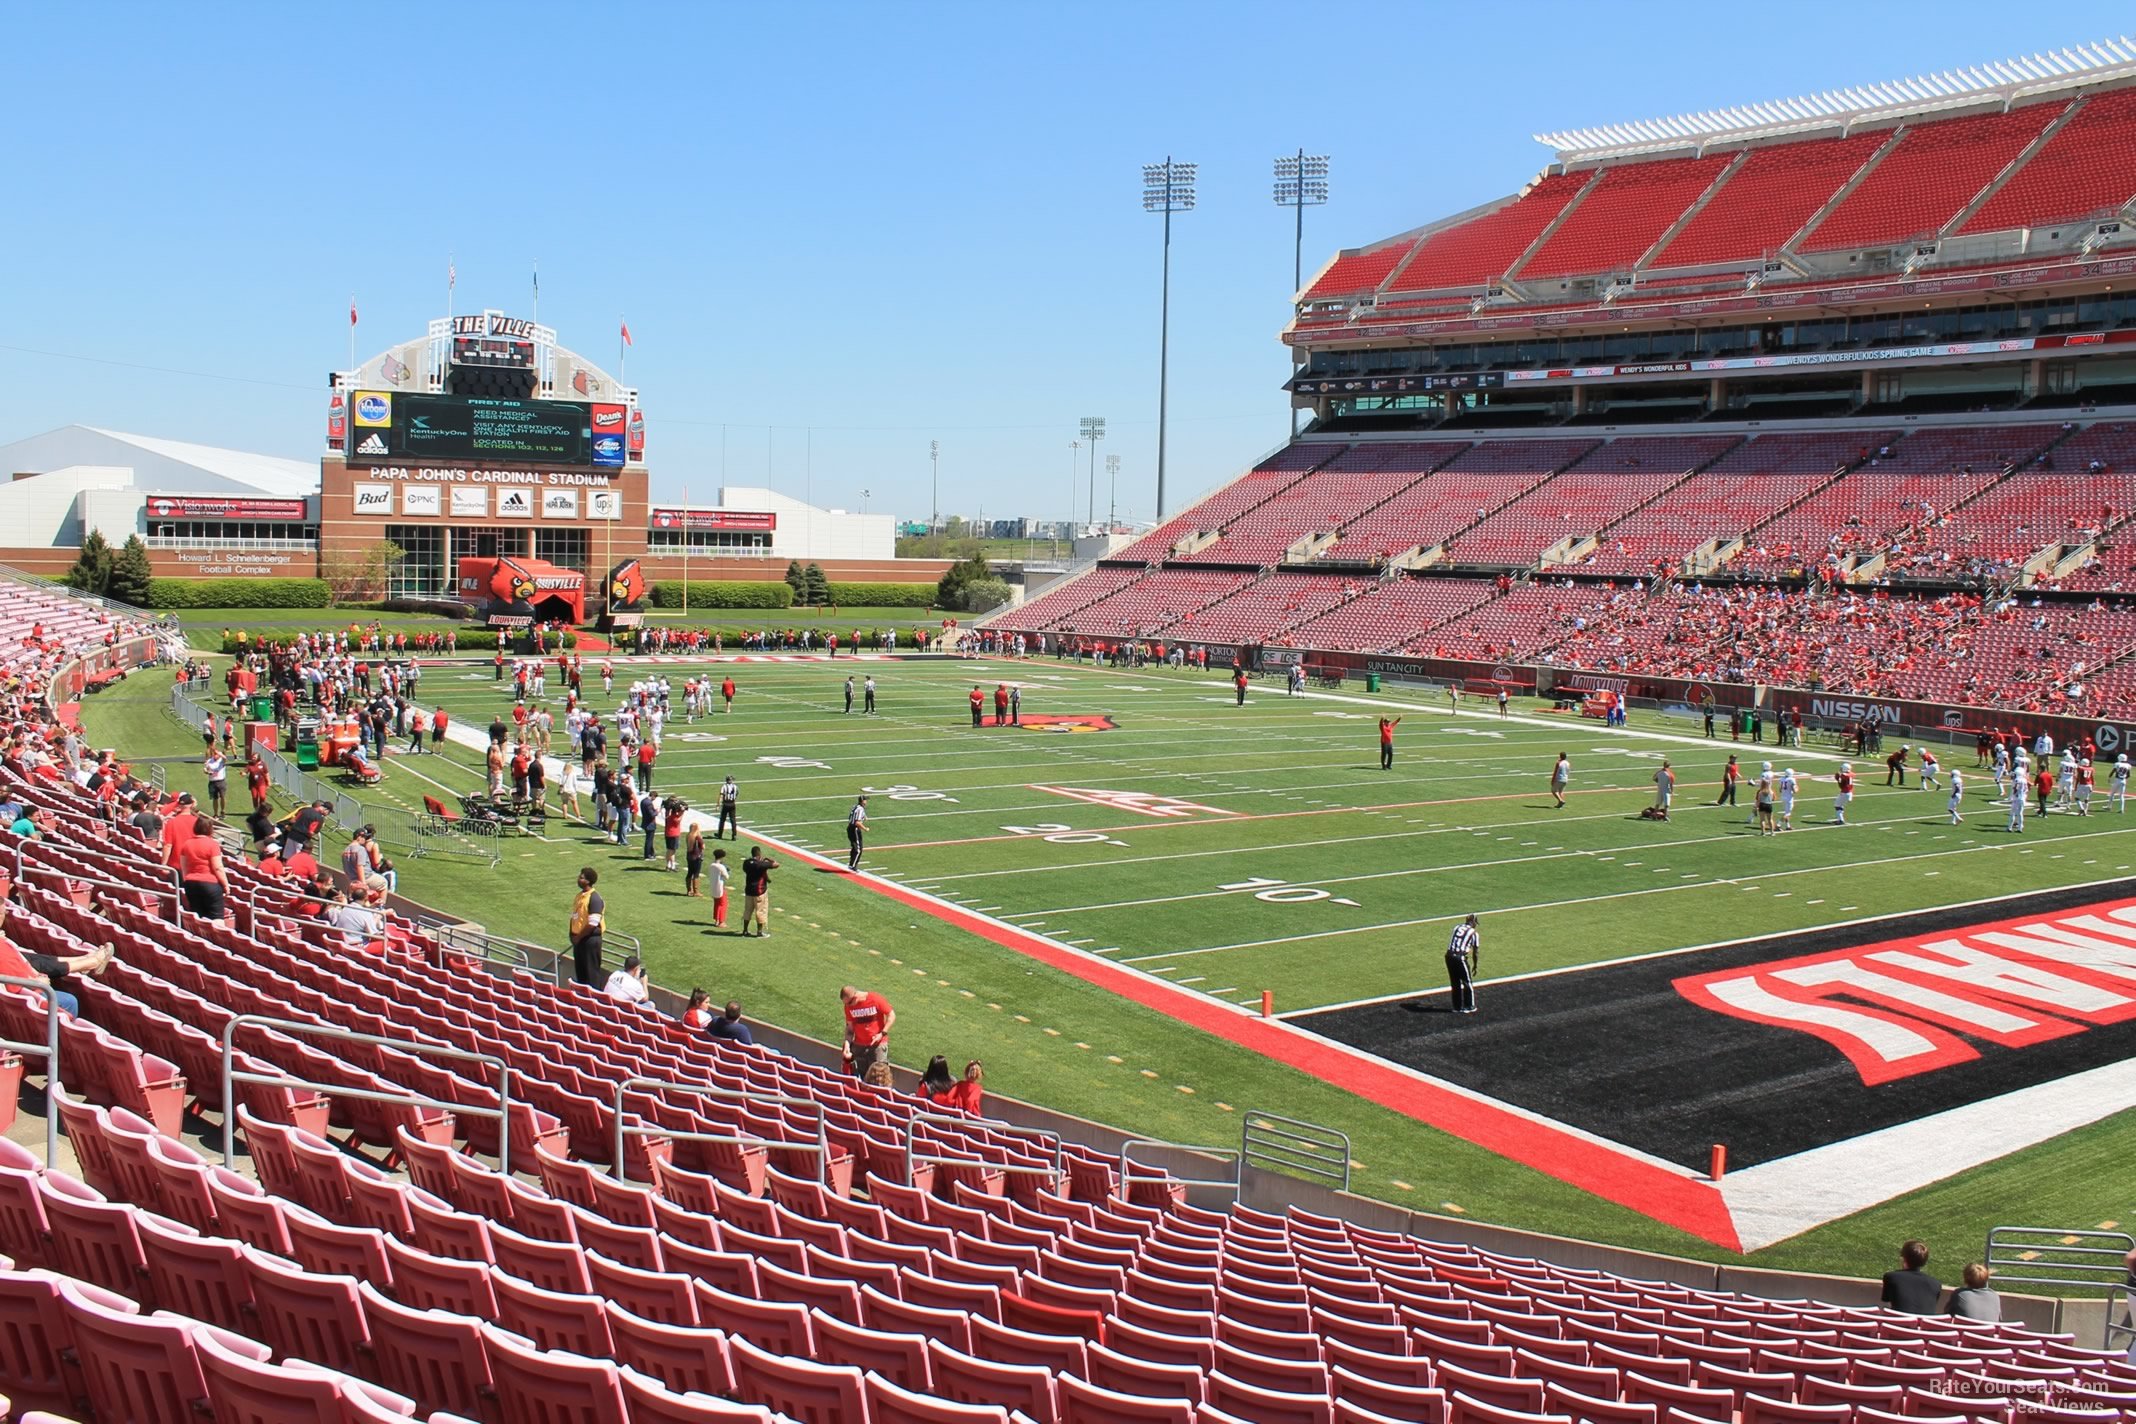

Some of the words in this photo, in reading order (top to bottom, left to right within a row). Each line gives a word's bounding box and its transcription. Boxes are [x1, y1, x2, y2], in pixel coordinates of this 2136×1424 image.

[1916, 281, 1941, 289] DWAYNE
[1943, 278, 1978, 286] WOODRUFF
[453, 316, 485, 334] THE
[491, 316, 535, 339] VILLE
[1819, 352, 1860, 364] WONDERFUL
[1880, 348, 1907, 359] SPRING
[1909, 347, 1932, 357] GAME
[1620, 365, 1643, 374] WENDY'S
[1644, 364, 1675, 373] WONDERFUL
[1676, 363, 1687, 371] KIDS
[361, 400, 386, 417] Kroger
[410, 428, 468, 436] KentuckyOne
[357, 446, 389, 455] adidas
[370, 467, 409, 480] PAPA
[415, 468, 466, 481] JOHN'S
[471, 470, 543, 484] CARDINAL
[548, 473, 609, 486] STADIUM
[357, 490, 390, 506] Bud
[417, 496, 436, 504] PNC
[176, 499, 238, 512] Visionworks
[179, 553, 211, 562] Howard
[226, 554, 291, 564] Schnellenberger
[199, 565, 232, 574] Football
[235, 566, 272, 575] Complex
[1208, 645, 1238, 657] NORTON
[1367, 661, 1385, 671] SUN
[1385, 662, 1403, 673] TAN
[1404, 664, 1424, 674] CITY
[1571, 674, 1629, 693] LOUISVILLE
[1812, 699, 1901, 723] NISSAN
[861, 785, 946, 800] 30
[999, 823, 1109, 843] 20
[1216, 877, 1331, 902] 10
